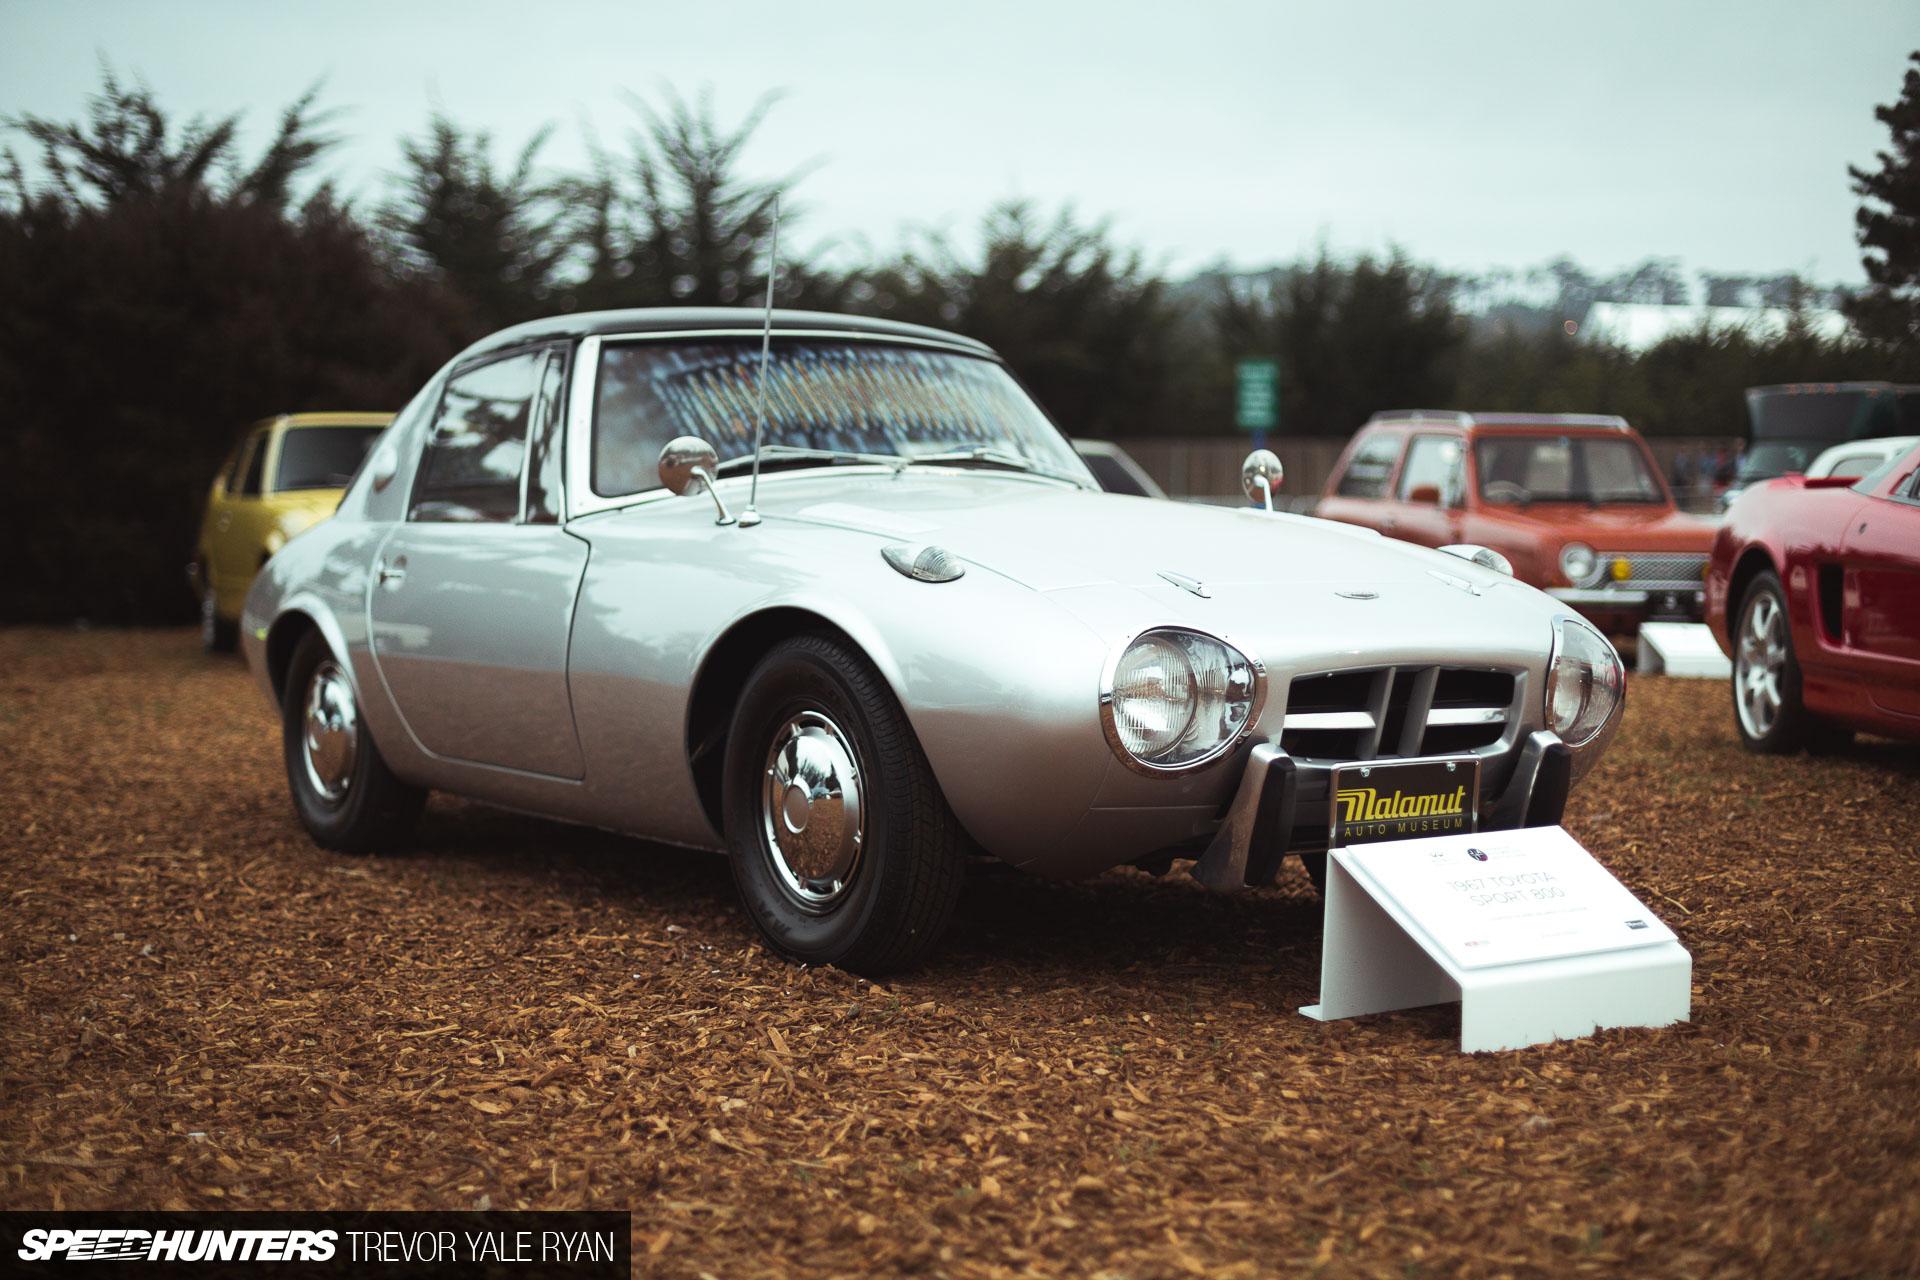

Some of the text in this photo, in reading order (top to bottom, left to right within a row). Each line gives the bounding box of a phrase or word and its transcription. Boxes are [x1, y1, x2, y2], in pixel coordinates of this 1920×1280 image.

[1337, 785, 1466, 822] Malamut
[1344, 818, 1463, 837] AUTO MUSEUM
[1446, 871, 1558, 893] 1967 TOYOTA
[1470, 886, 1566, 907] SPORT 800
